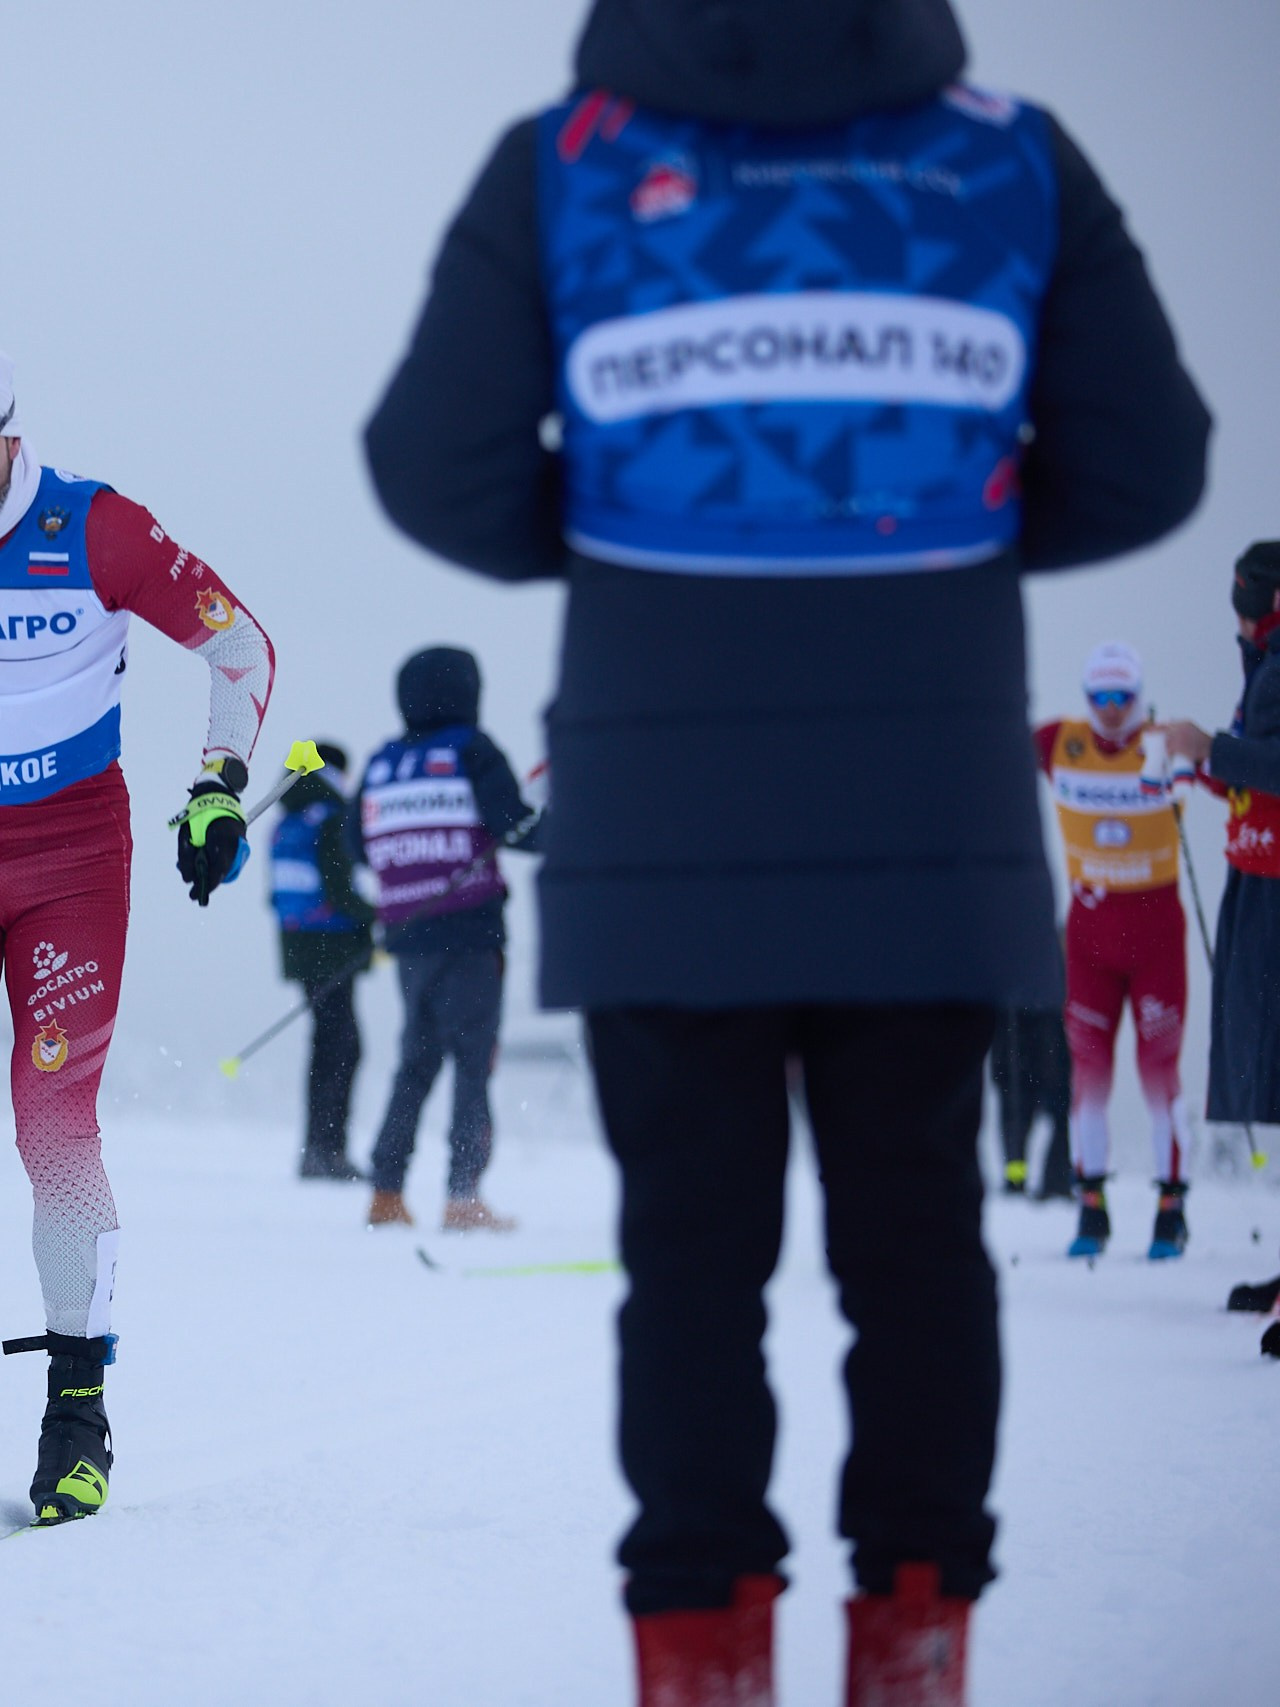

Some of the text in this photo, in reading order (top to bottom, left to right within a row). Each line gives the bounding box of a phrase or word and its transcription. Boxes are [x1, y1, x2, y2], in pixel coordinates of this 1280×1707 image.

[589, 323, 914, 396] ПЕРСОНАЛ
[27, 960, 99, 1006] ФОСАГРО
[32, 979, 105, 1022] BIVIUM
